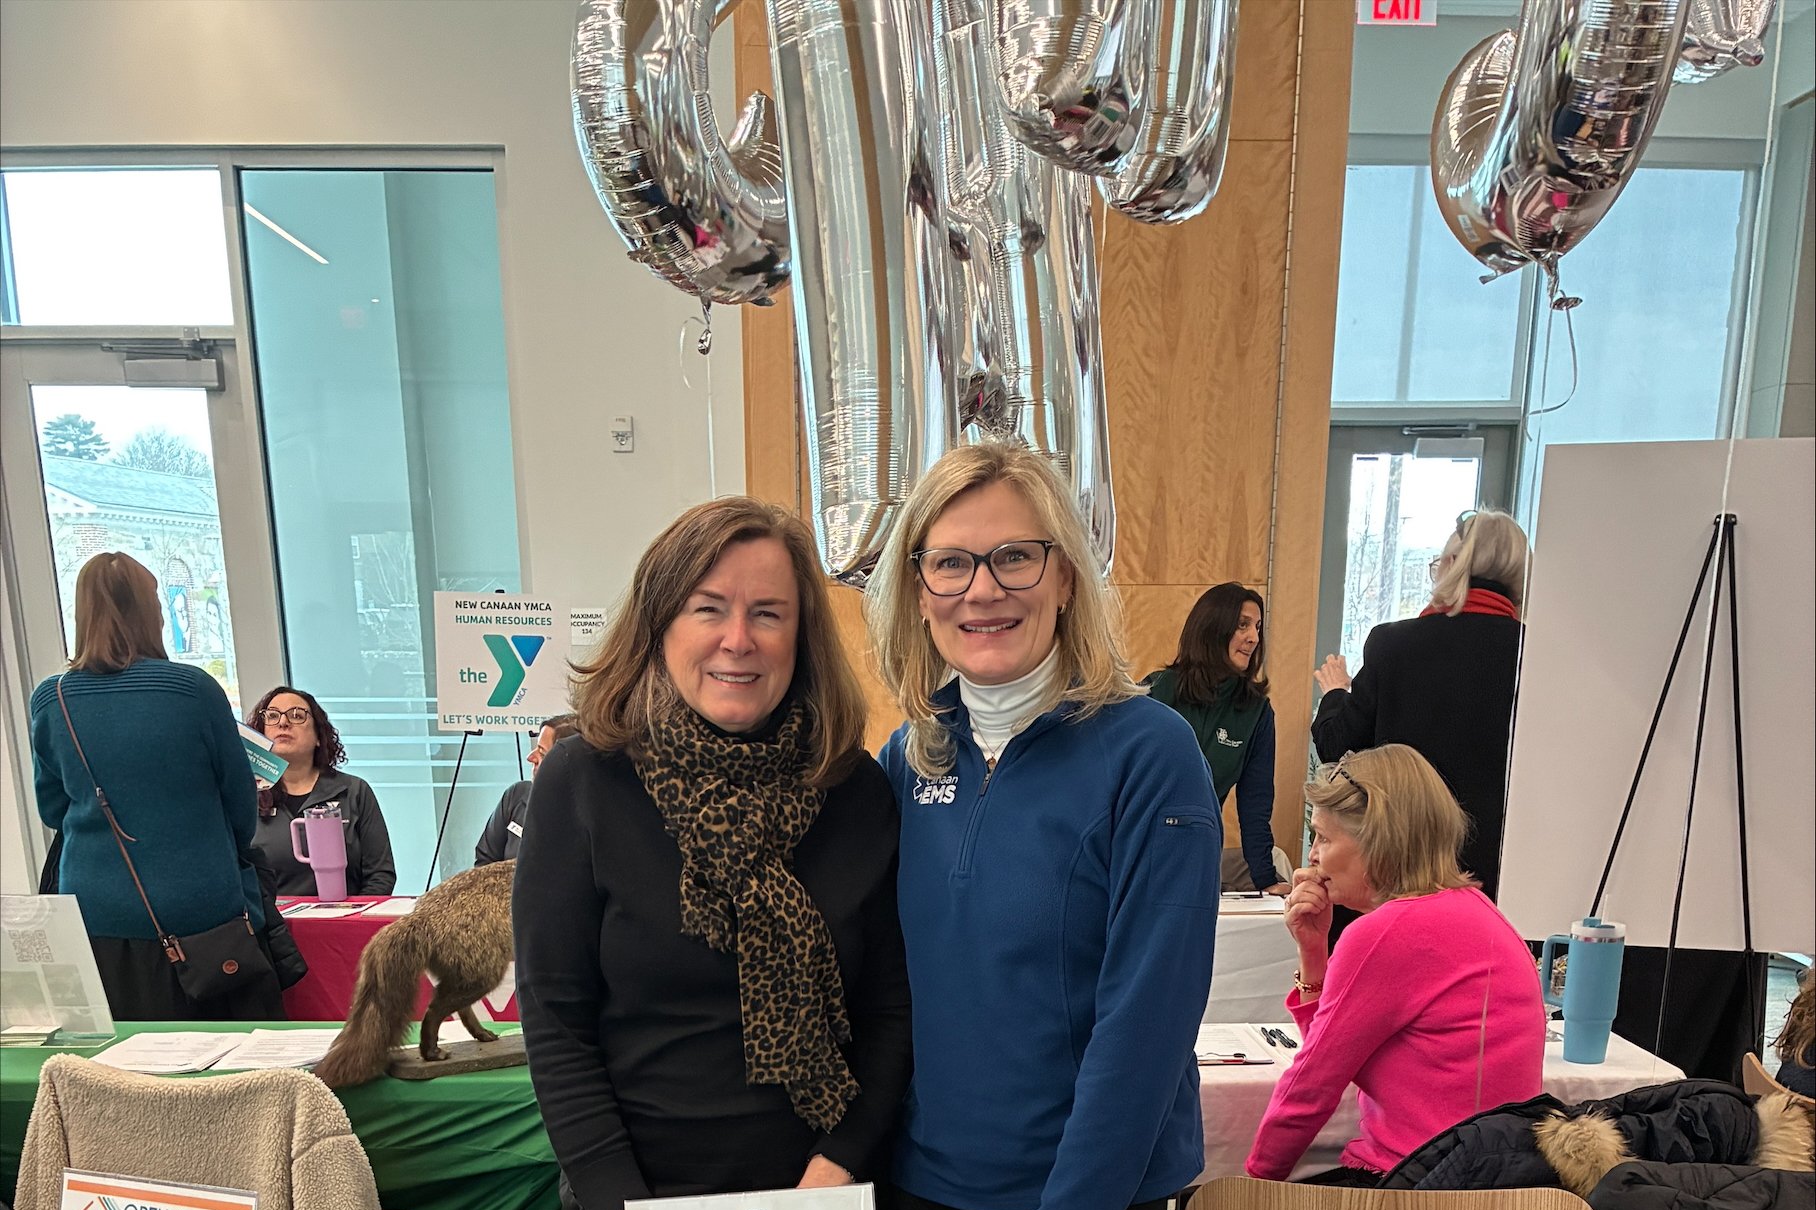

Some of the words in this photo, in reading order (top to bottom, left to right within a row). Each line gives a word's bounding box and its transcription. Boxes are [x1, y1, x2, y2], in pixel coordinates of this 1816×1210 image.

[1374, 0, 1420, 20] EXIT
[455, 600, 478, 609] NEW
[480, 601, 521, 610] CANAAN
[524, 602, 552, 611] YMCA
[455, 615, 493, 624] HUMAN
[495, 616, 552, 626] RESOURCES
[459, 667, 488, 683] the
[513, 687, 528, 706] YMCA
[443, 714, 472, 725] LET'S
[475, 715, 509, 725] WORK
[511, 716, 550, 725] TOGE
[919, 785, 957, 804] EMS
